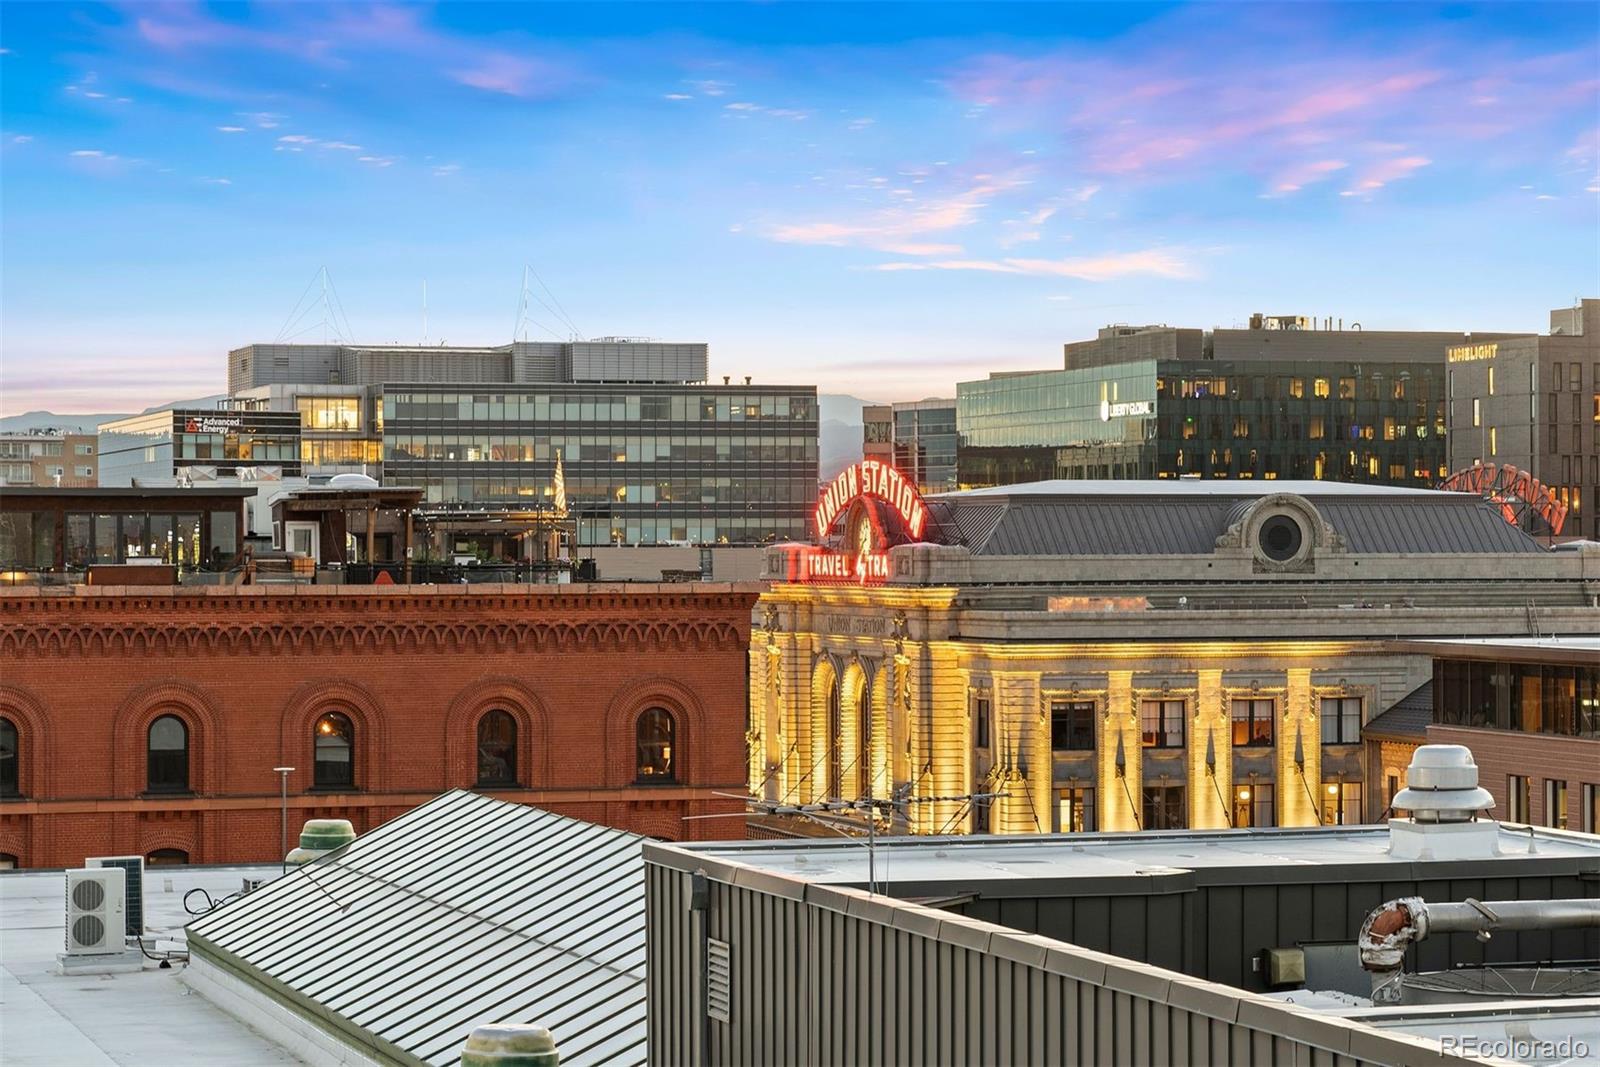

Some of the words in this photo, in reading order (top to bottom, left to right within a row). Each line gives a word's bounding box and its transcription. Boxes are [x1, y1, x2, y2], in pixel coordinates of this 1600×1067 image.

[1448, 344, 1498, 362] LIMELIGHT
[203, 417, 240, 426] Advanced
[203, 425, 229, 434] Energy
[815, 463, 858, 538] UNION
[861, 460, 923, 539] STATION
[808, 554, 850, 577] TRAVEL
